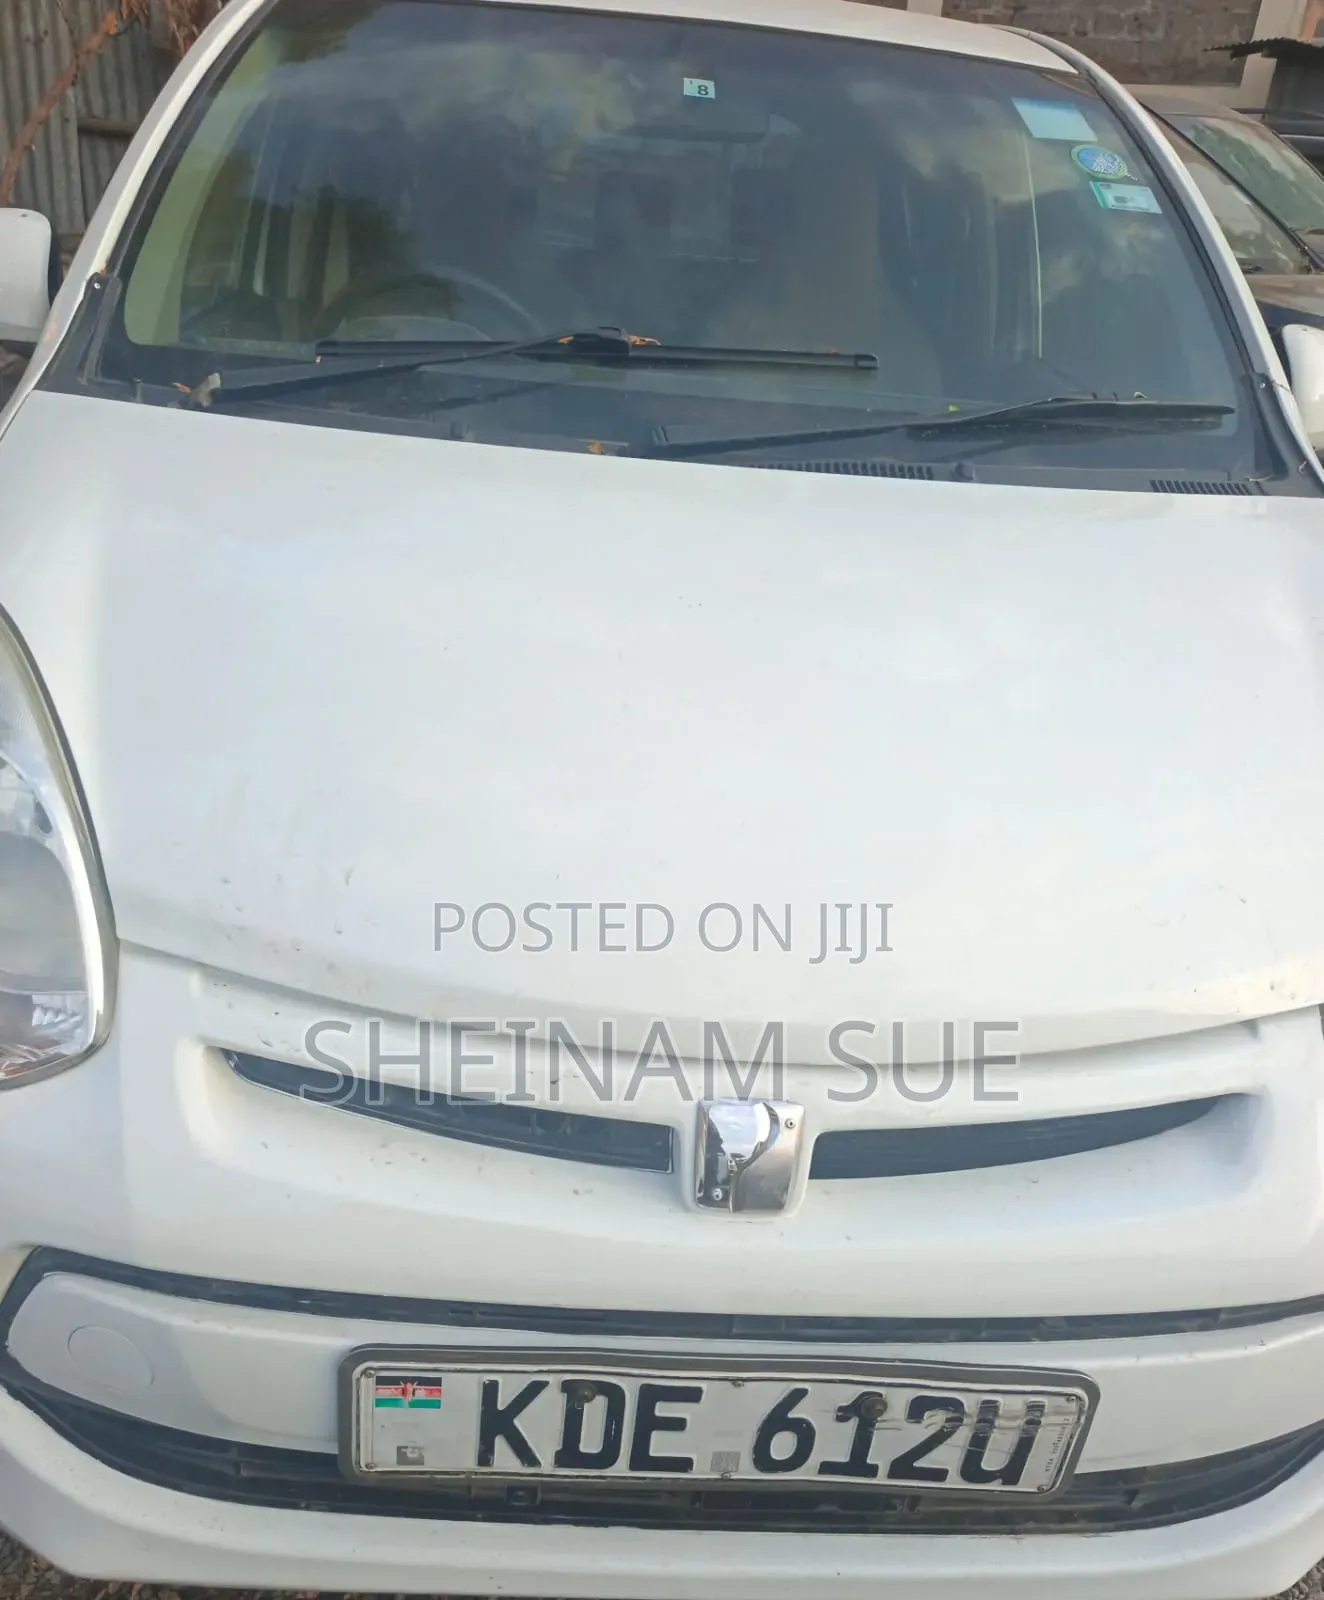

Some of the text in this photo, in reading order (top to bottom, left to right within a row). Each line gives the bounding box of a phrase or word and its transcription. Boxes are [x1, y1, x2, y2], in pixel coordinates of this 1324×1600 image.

[697, 84, 709, 96] 8
[477, 1377, 704, 1473] KDE
[752, 1387, 1046, 1486] 612U
